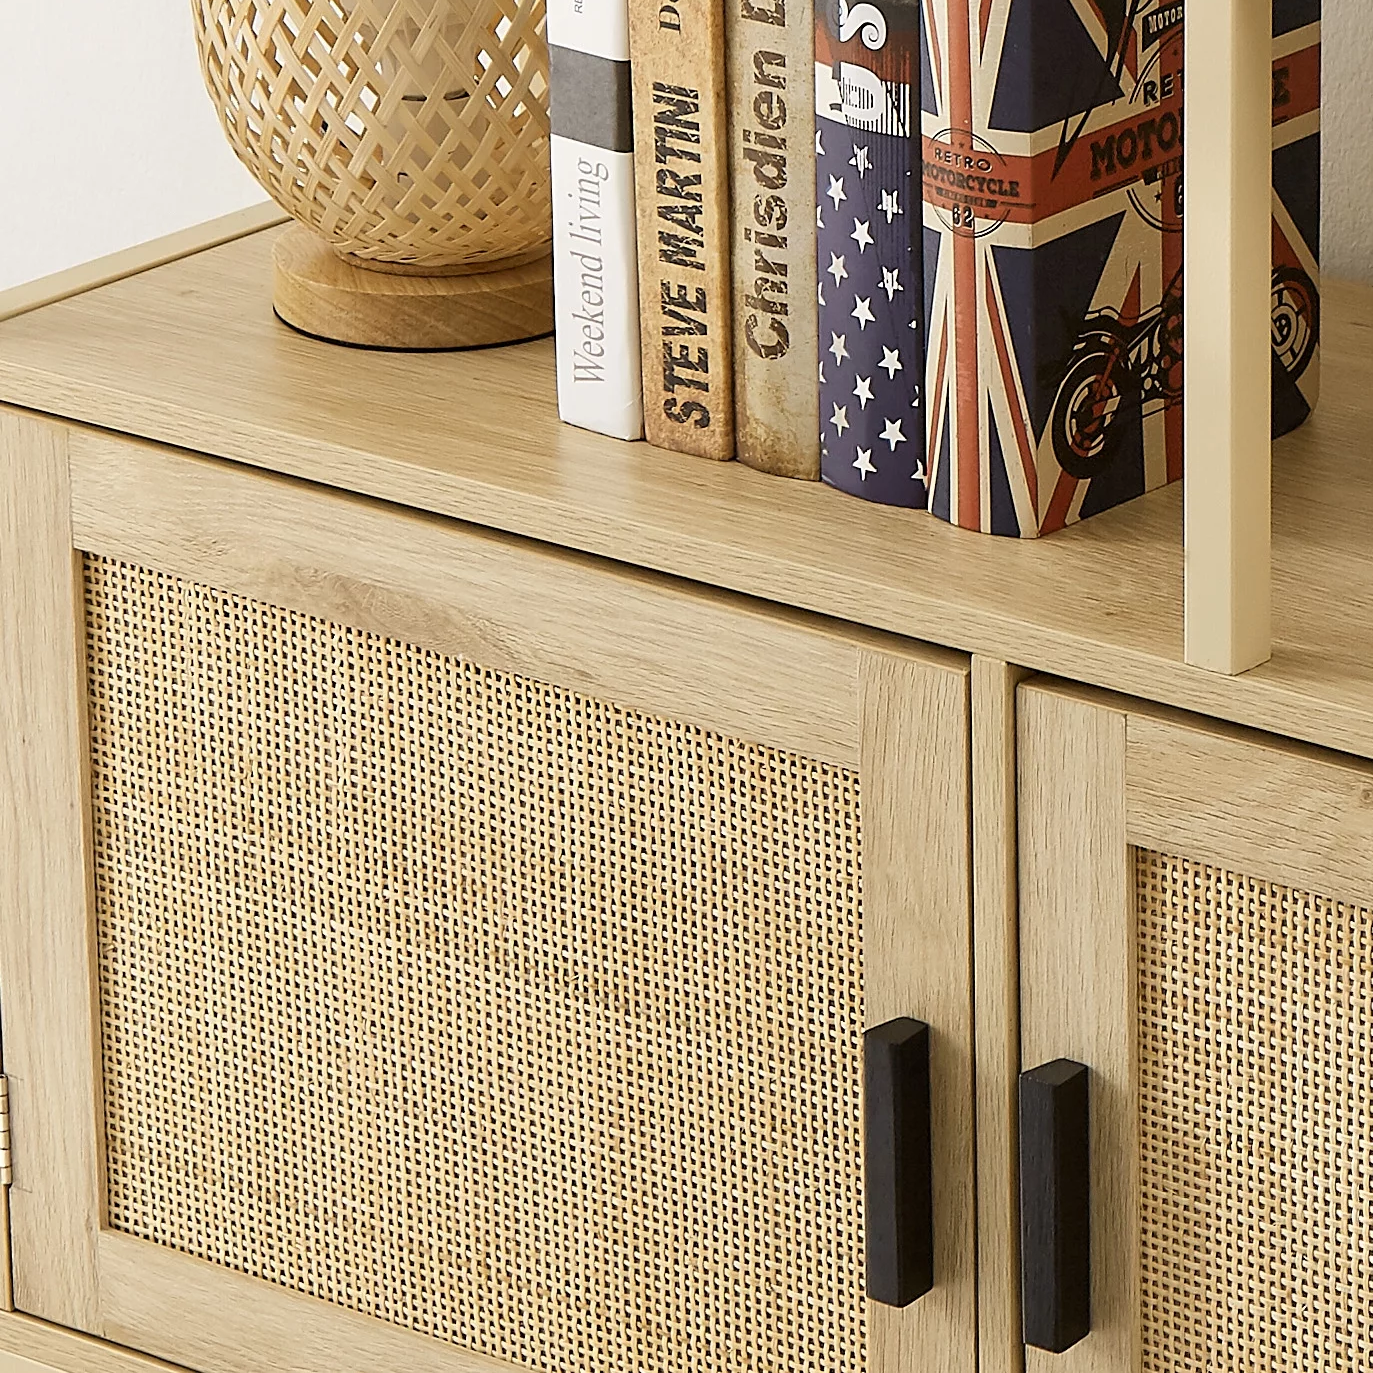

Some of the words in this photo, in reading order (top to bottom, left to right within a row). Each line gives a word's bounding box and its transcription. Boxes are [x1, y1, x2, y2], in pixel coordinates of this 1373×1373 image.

[567, 157, 609, 247] living
[651, 81, 706, 272] MARTINI
[742, 50, 790, 361] Chrisdien
[934, 147, 993, 173] RETRO
[1089, 109, 1184, 181] MOTO
[569, 249, 605, 384] Weekend
[659, 278, 711, 430] STEVE
